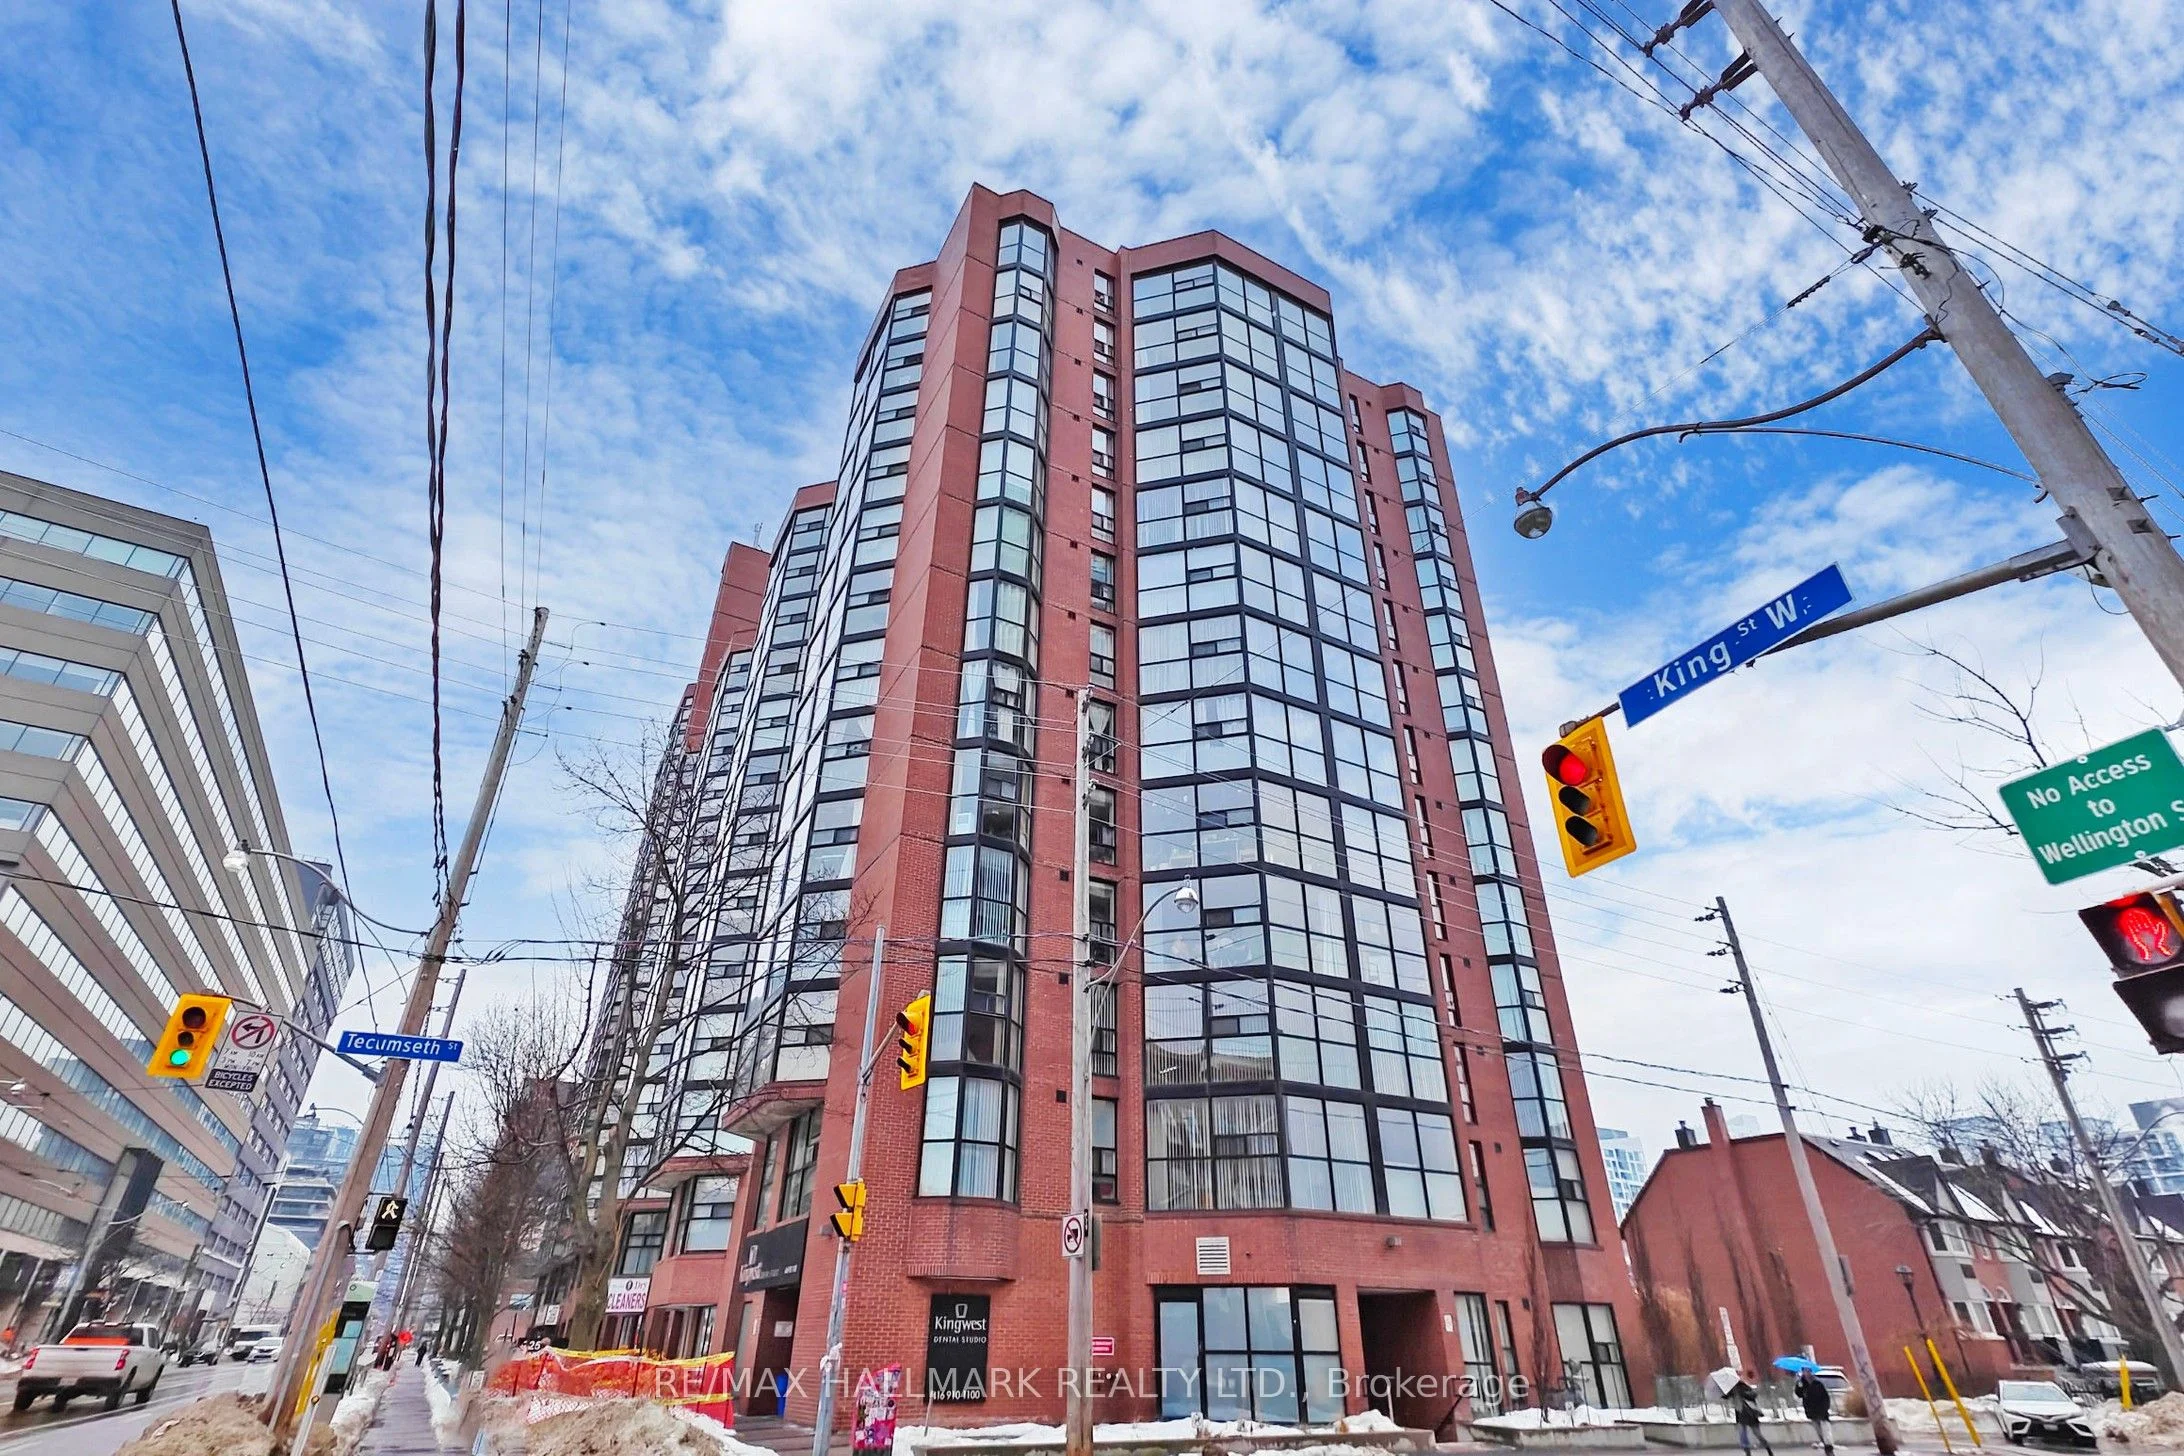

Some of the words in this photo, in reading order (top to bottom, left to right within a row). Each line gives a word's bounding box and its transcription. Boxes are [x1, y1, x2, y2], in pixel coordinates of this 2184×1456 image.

[1653, 640, 1732, 698] King
[1737, 617, 1758, 637] St
[1765, 593, 1798, 630] W
[2026, 787, 2061, 810] No
[2067, 753, 2152, 796] Access
[2087, 798, 2116, 818] to
[2037, 810, 2168, 865] Wellington
[2170, 799, 2184, 822] S
[346, 1033, 441, 1055] Tecumseth
[447, 1041, 459, 1051] St
[208, 1080, 253, 1090] EXCEPTED
[213, 1071, 254, 1081] BICYCLES
[607, 1292, 646, 1310] CLEANERS
[934, 1316, 987, 1334] Kingwest
